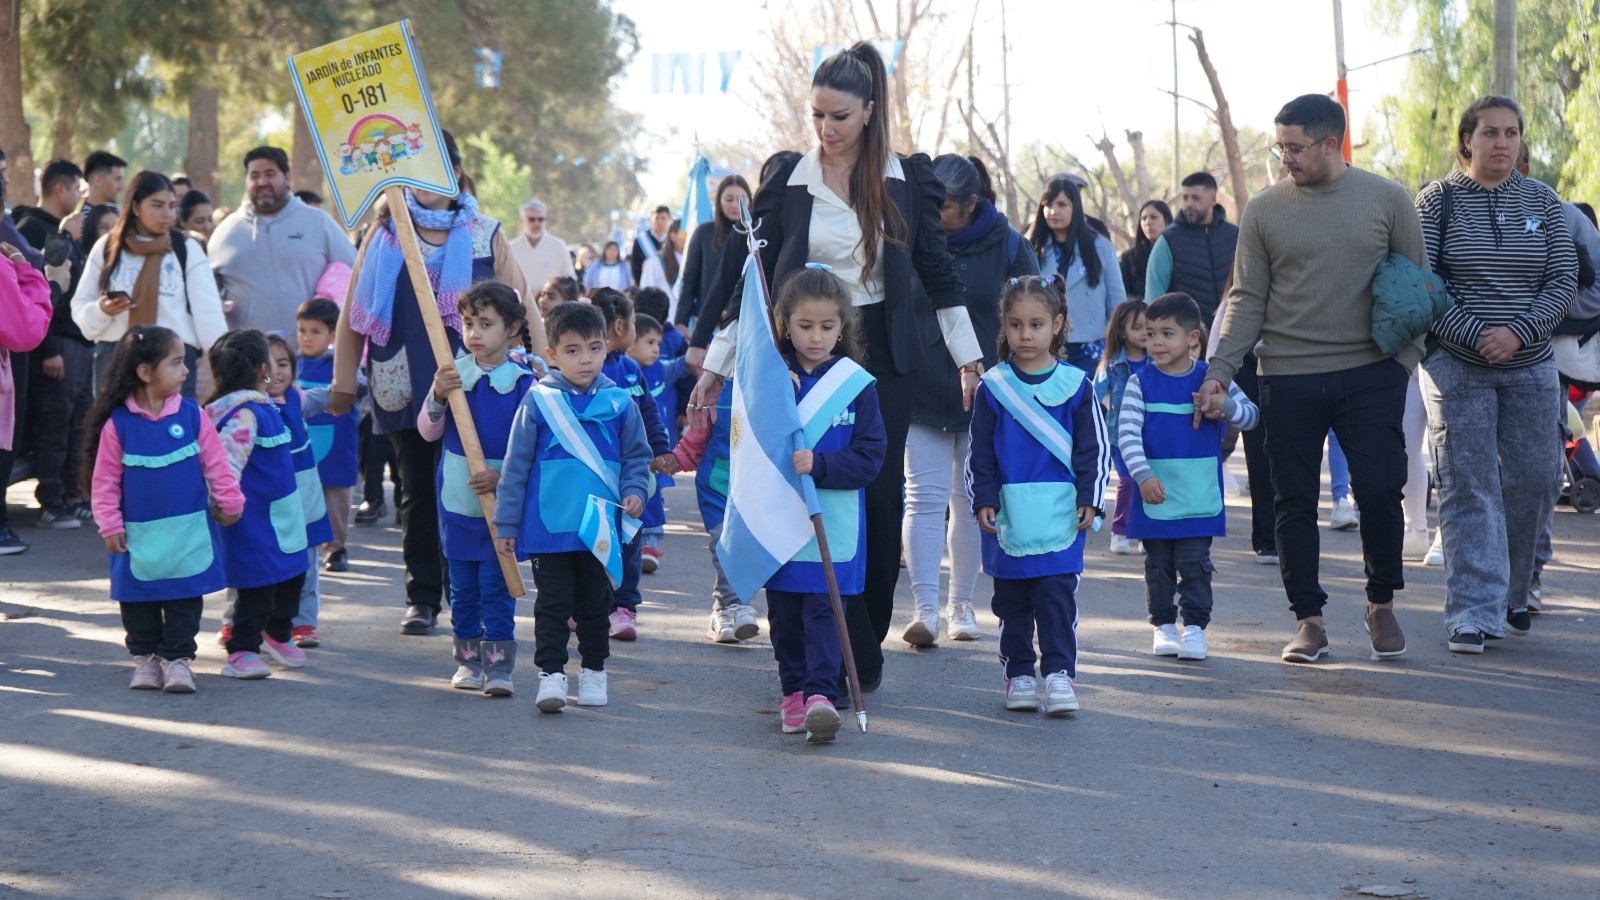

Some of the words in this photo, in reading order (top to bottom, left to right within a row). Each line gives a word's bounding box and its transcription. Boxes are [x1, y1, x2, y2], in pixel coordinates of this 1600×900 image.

[306, 61, 339, 84] JARDÍN
[340, 58, 353, 71] de
[353, 43, 402, 66] INFANTES
[332, 62, 382, 88] NUCLEADO
[341, 82, 387, 114] 0-181
